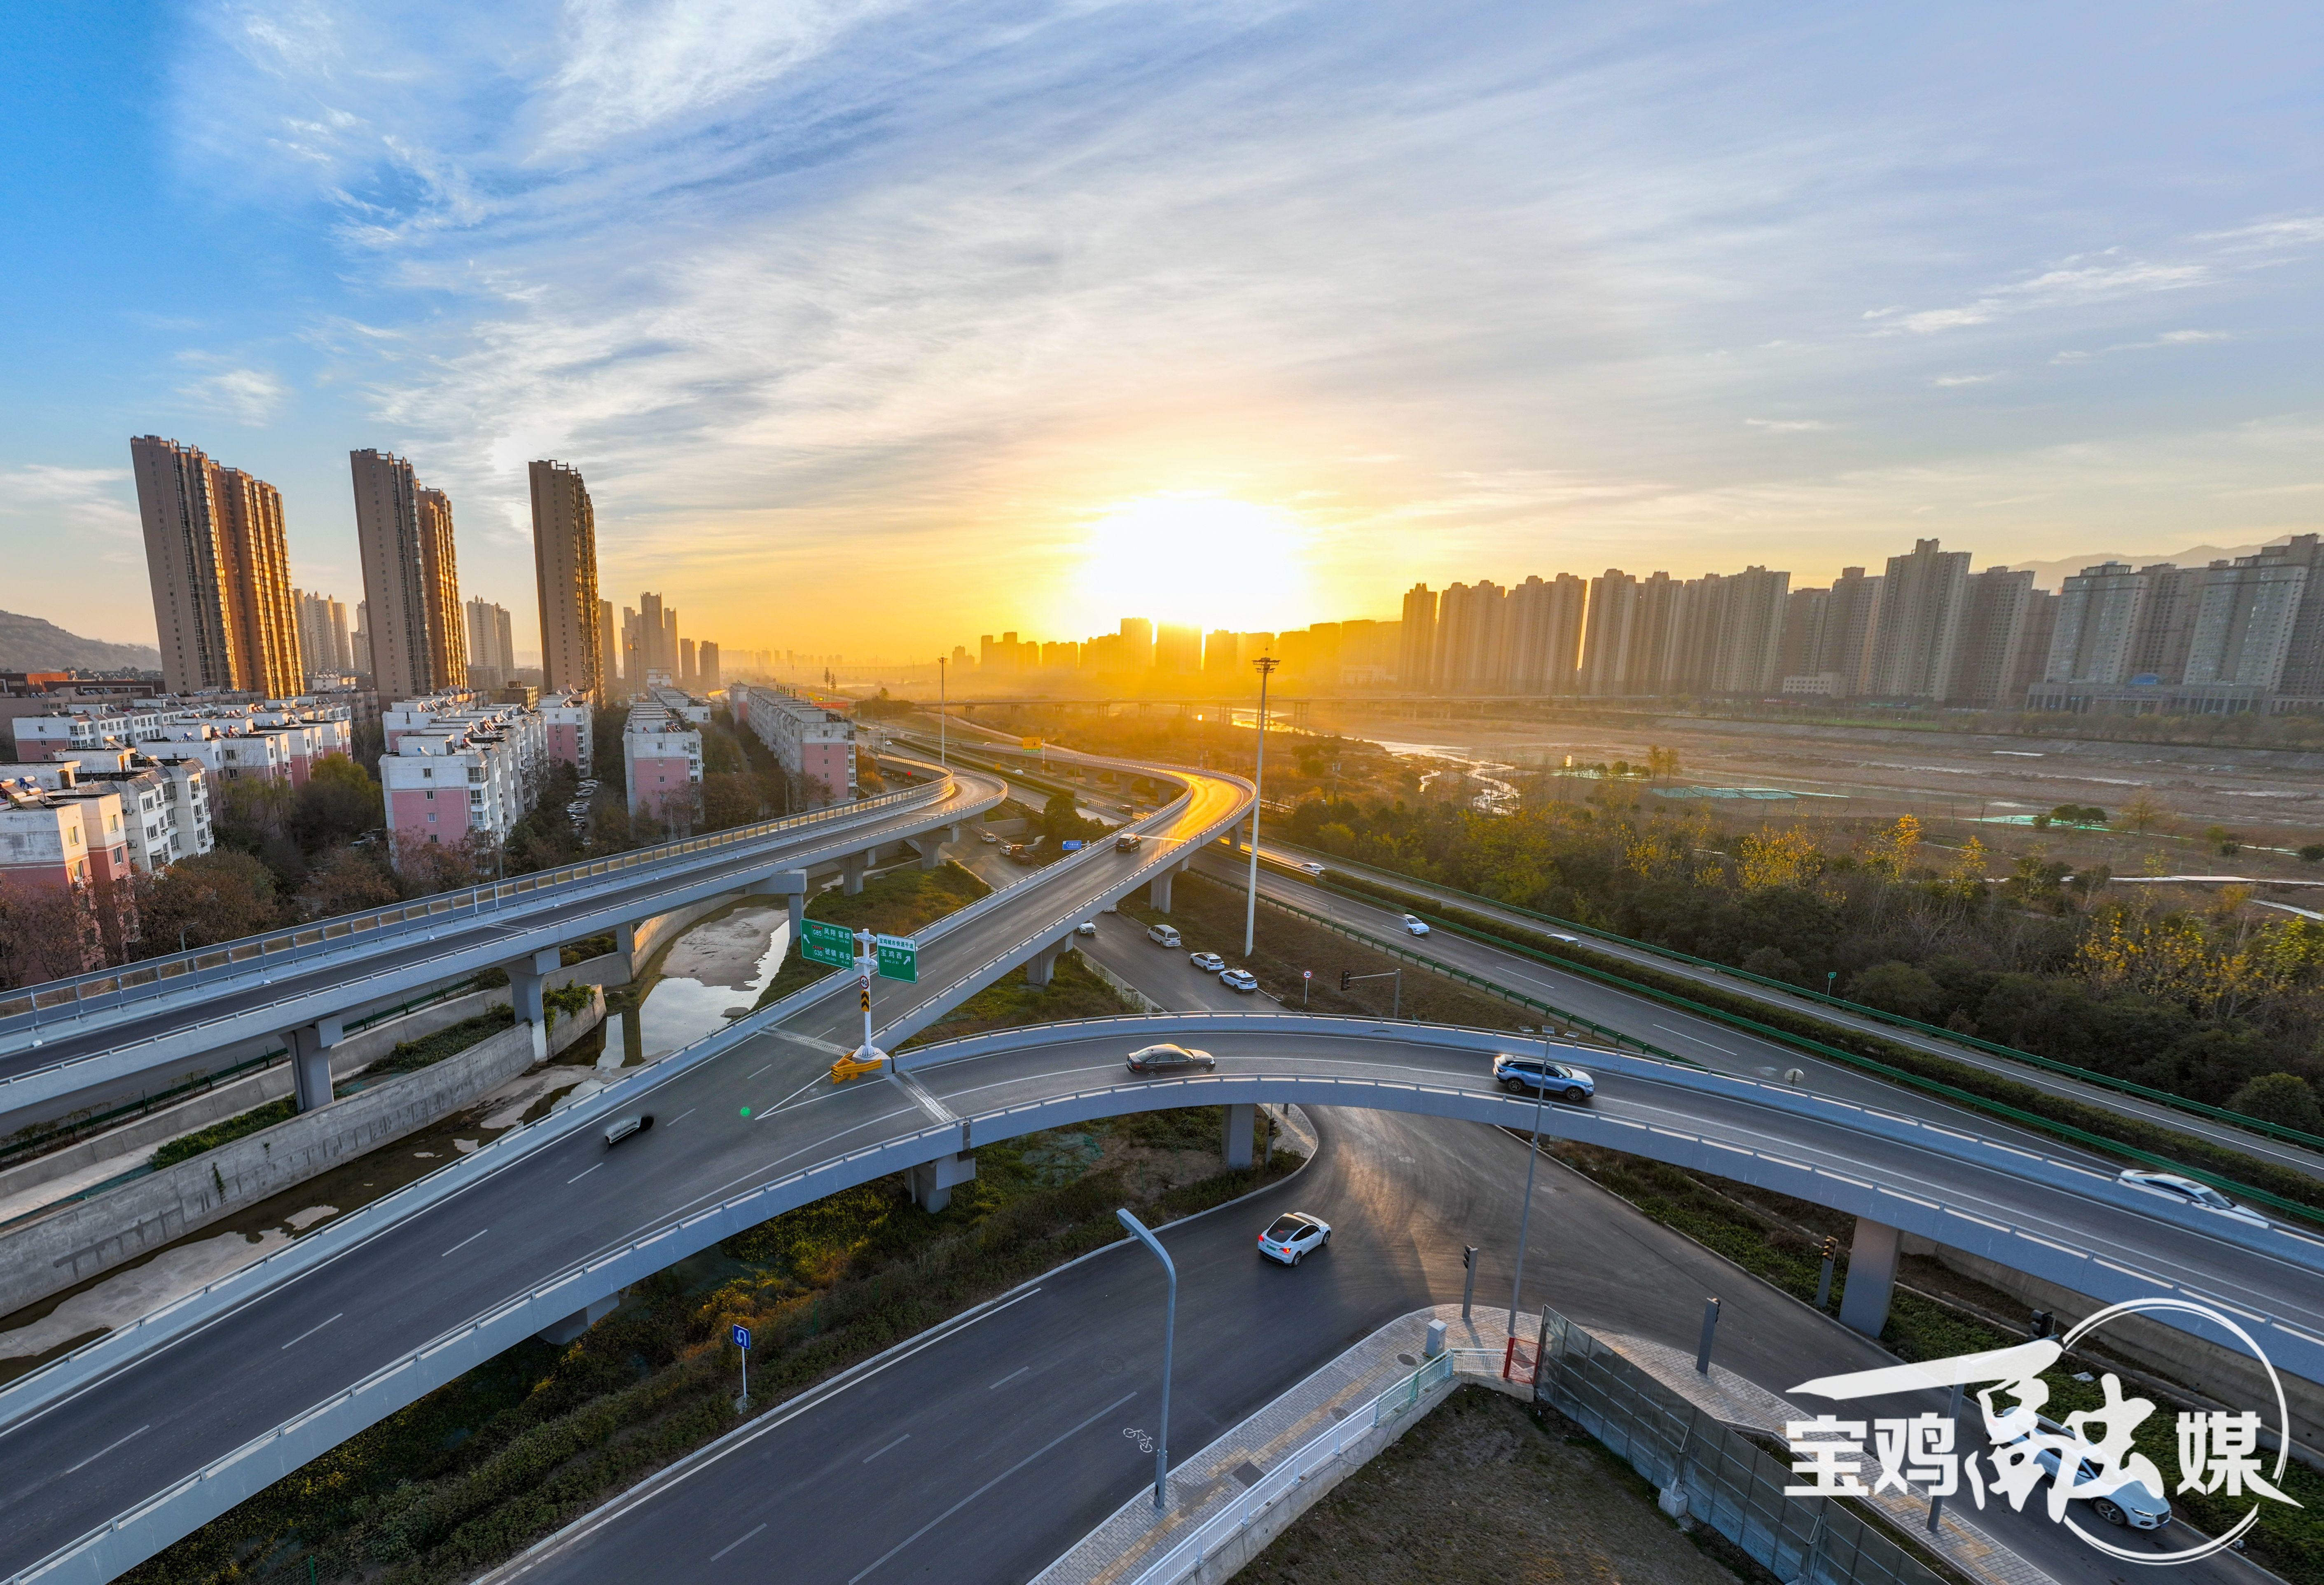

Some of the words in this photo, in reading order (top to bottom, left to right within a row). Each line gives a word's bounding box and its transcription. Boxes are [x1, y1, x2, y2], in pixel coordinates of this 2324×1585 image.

[824, 928, 836, 937] 凤翔
[838, 930, 850, 940] 留坝
[879, 938, 914, 949] 宝鸡城市快速干道
[839, 951, 851, 961] 西安
[881, 949, 902, 959] 宝鸡西
